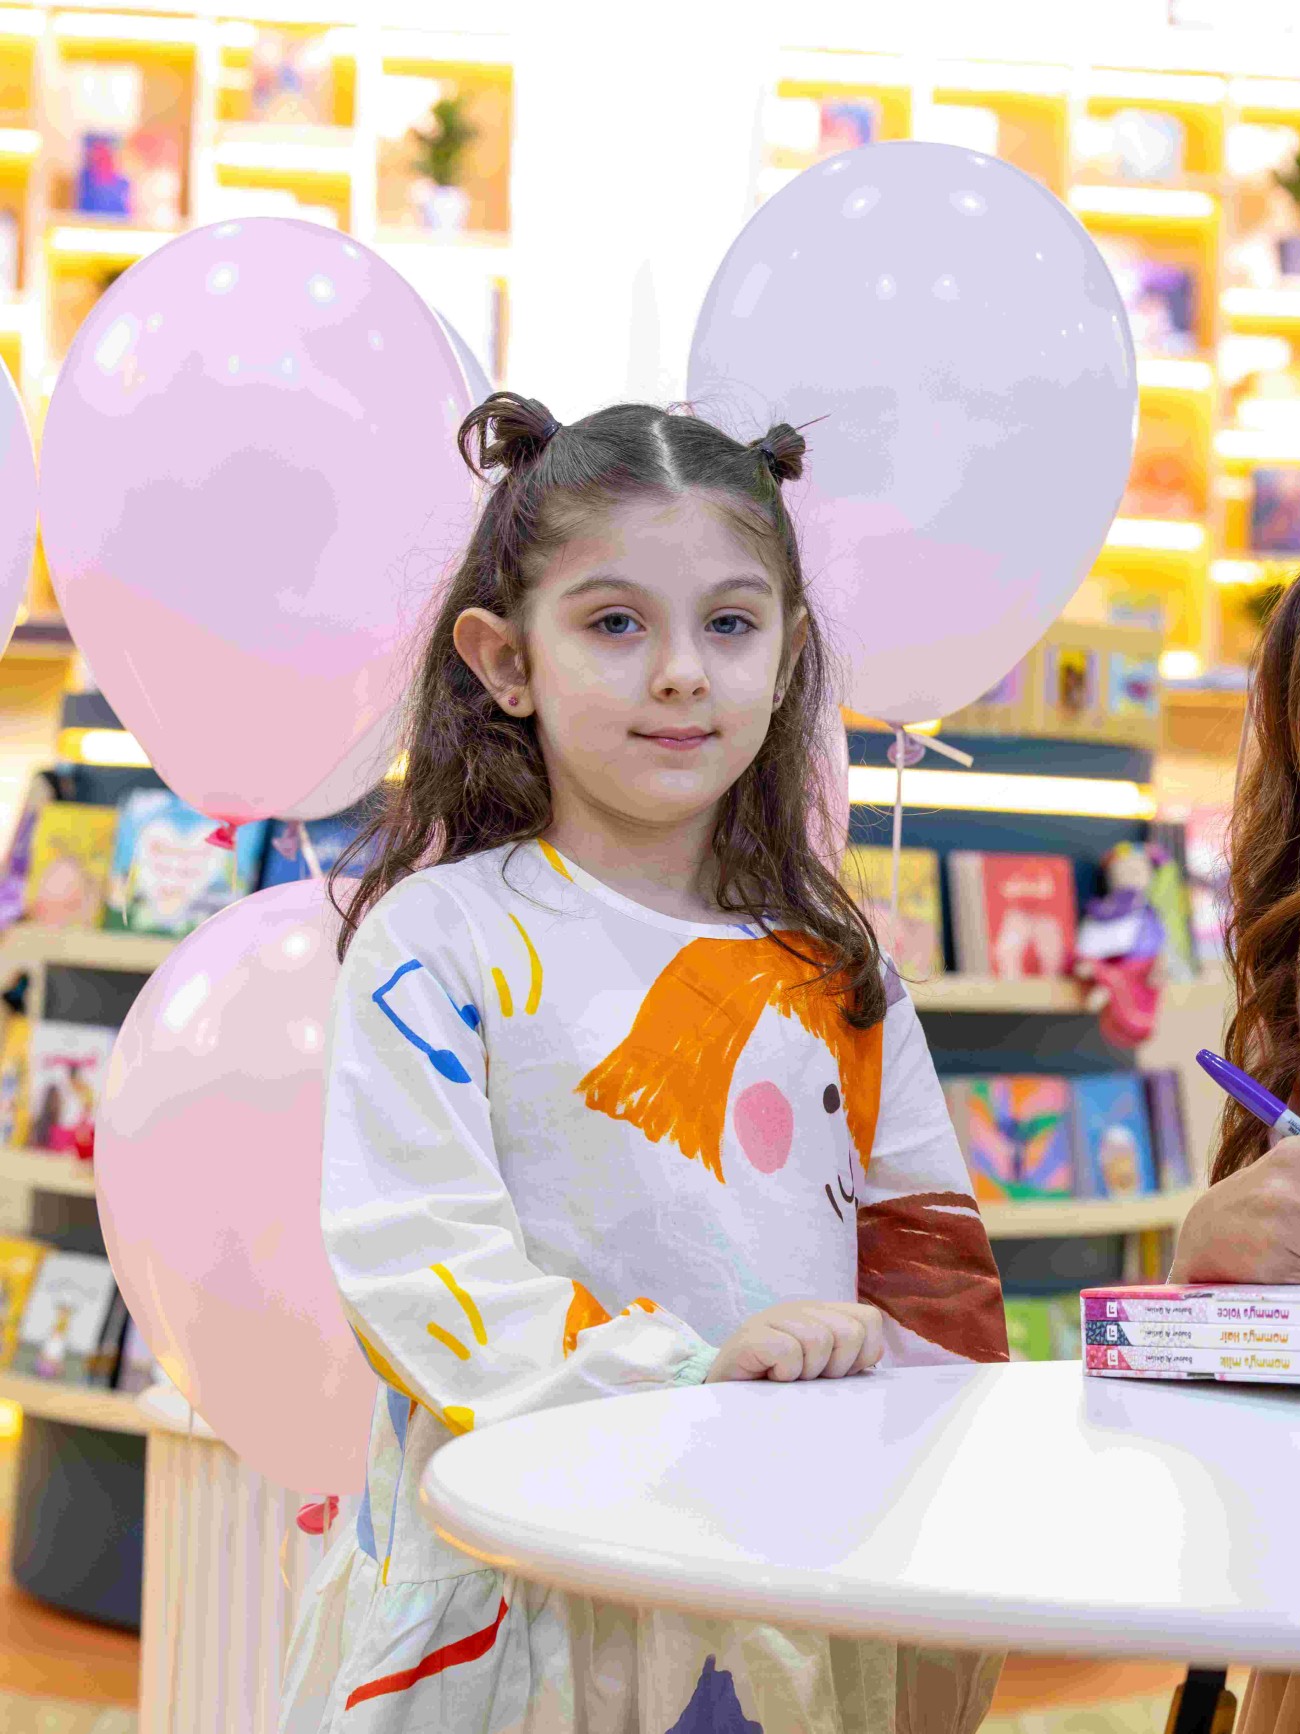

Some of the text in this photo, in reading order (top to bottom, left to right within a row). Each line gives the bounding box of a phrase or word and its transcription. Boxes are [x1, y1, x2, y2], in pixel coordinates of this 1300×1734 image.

[1217, 1305, 1290, 1320] mommy's Voice
[1220, 1329, 1289, 1344] mommy's Hair
[1244, 1355, 1291, 1369] mommy's
